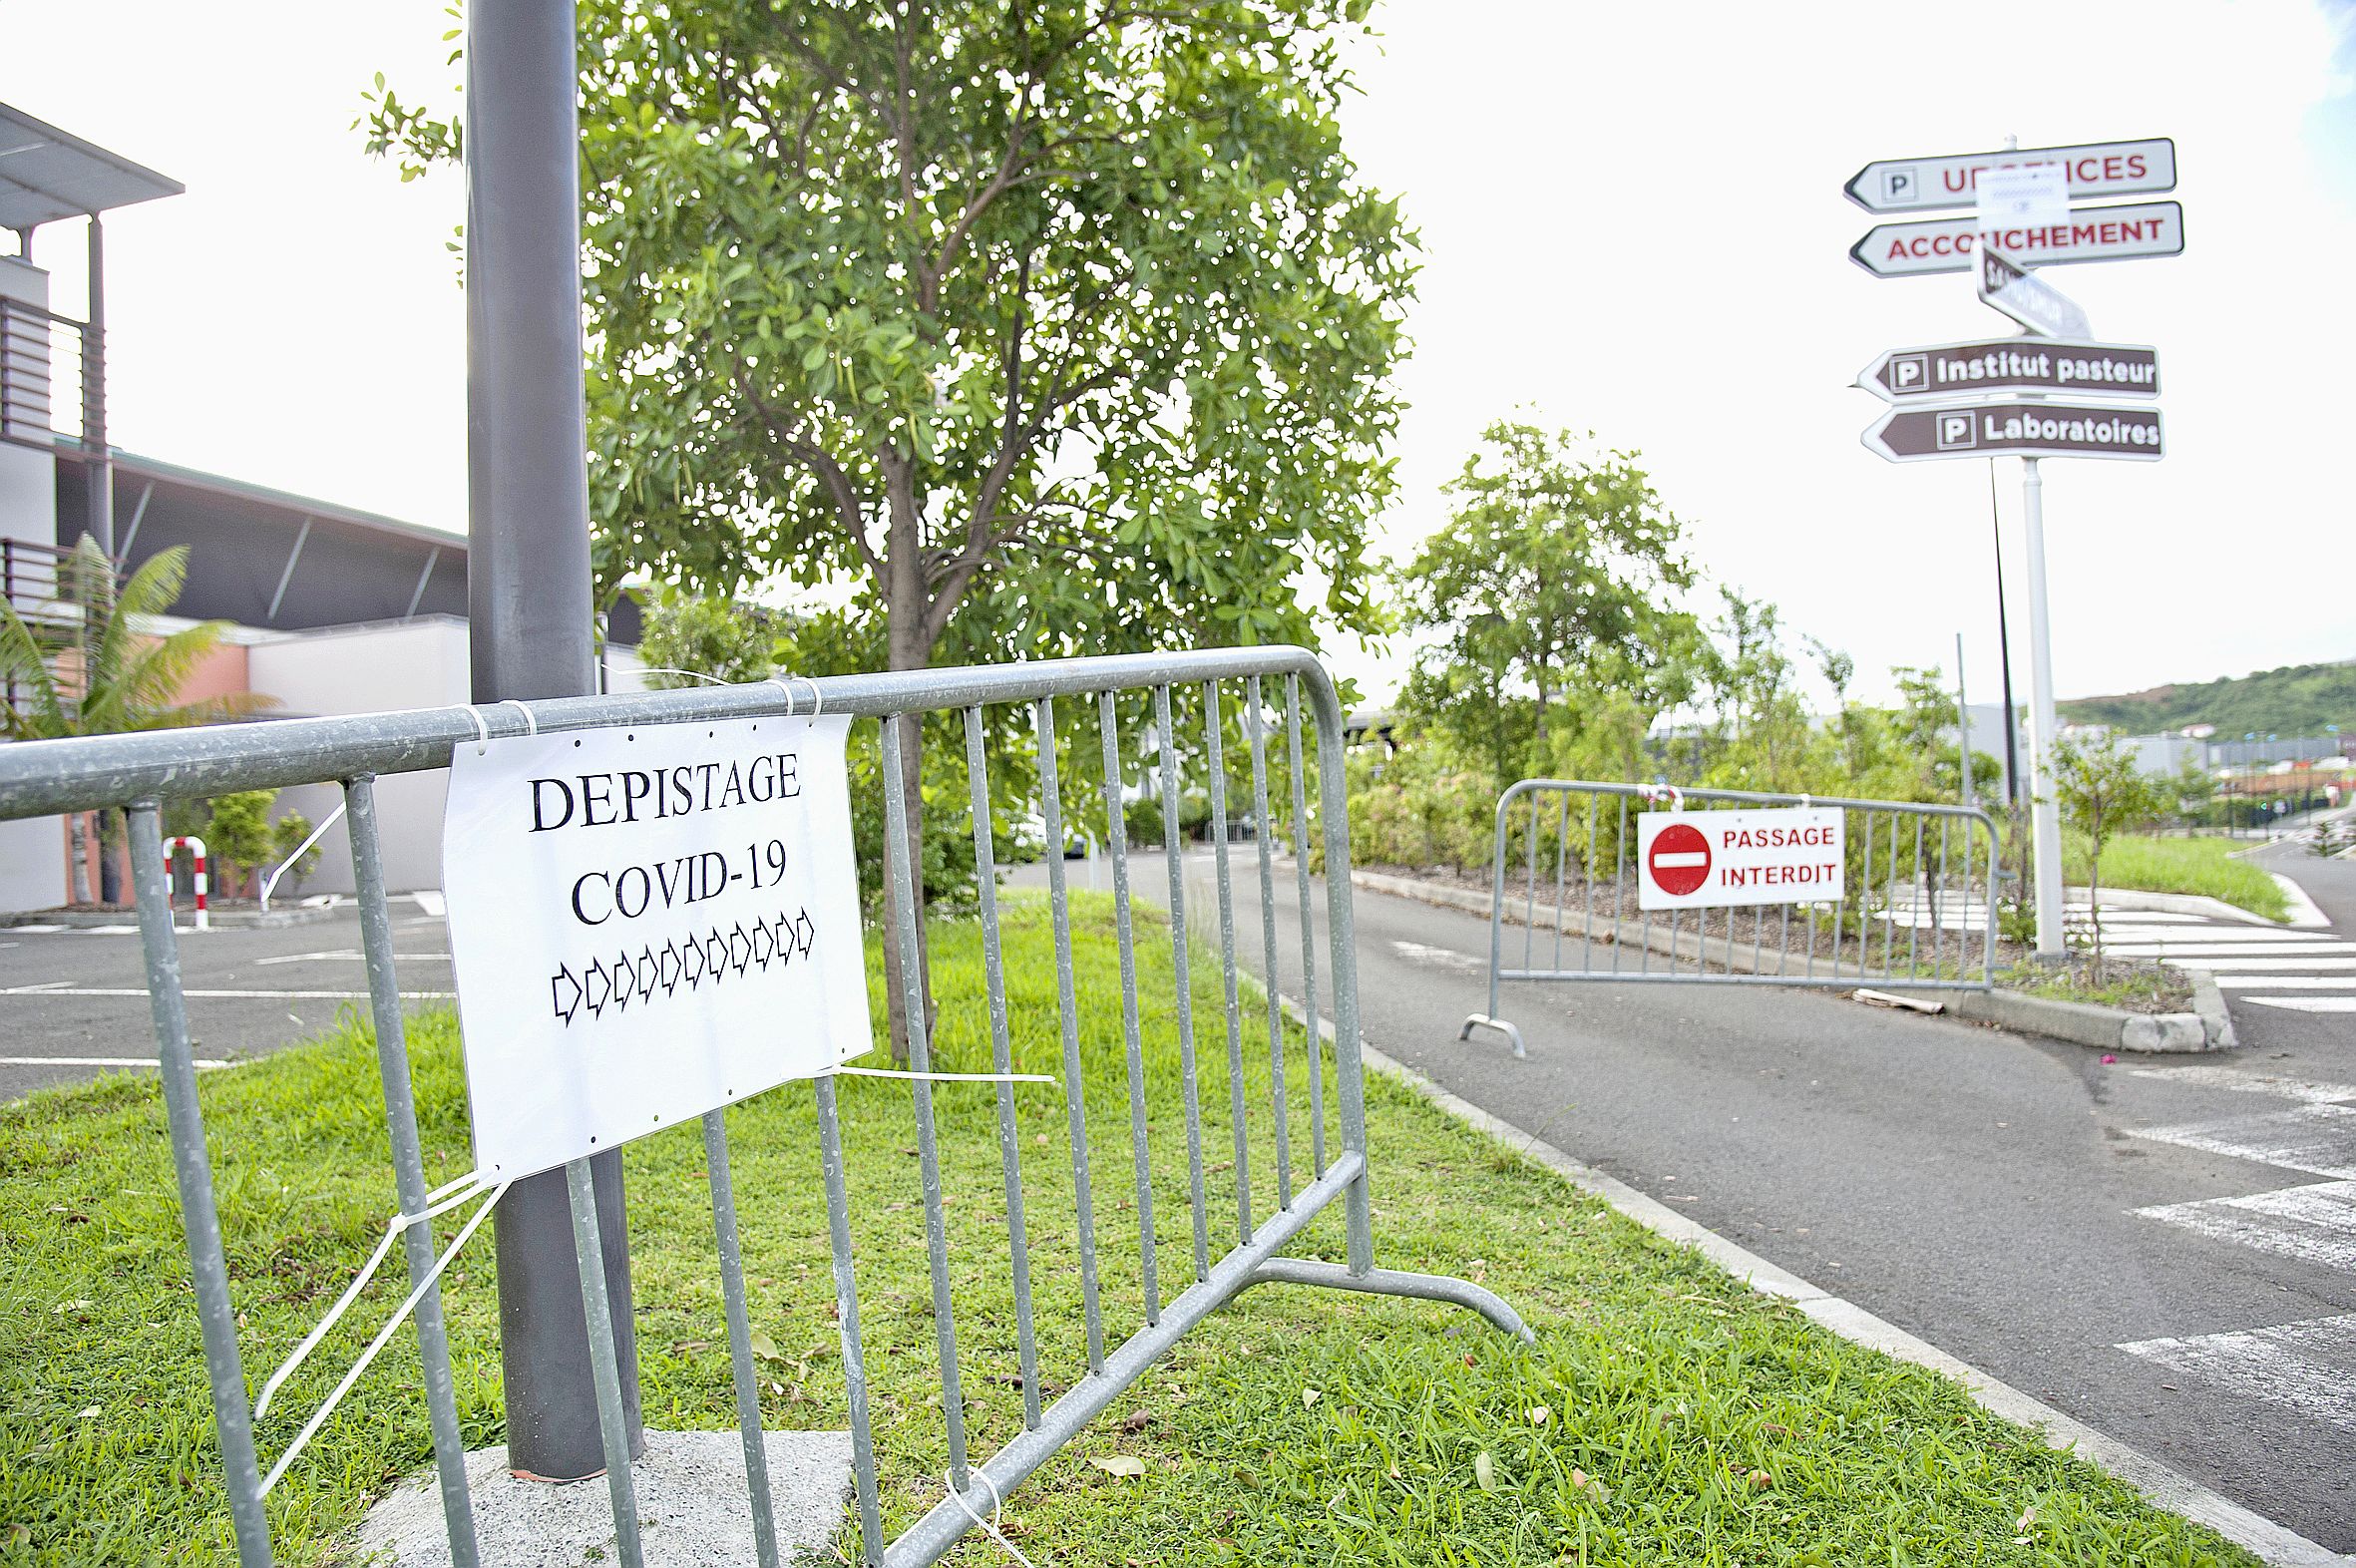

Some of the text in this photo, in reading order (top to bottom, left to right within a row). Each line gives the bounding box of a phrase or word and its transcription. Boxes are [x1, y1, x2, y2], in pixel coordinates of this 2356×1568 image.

[1891, 175, 1907, 195] P
[1943, 155, 2148, 193] UCES
[1898, 351, 2157, 387] P Institut pasteur
[1945, 412, 2160, 446] P Laboratoires
[527, 753, 802, 834] DEPISTAGE
[1723, 827, 1835, 848] PASSAGE
[571, 839, 788, 926] COVID-19
[1721, 864, 1836, 887] INTERDIT
